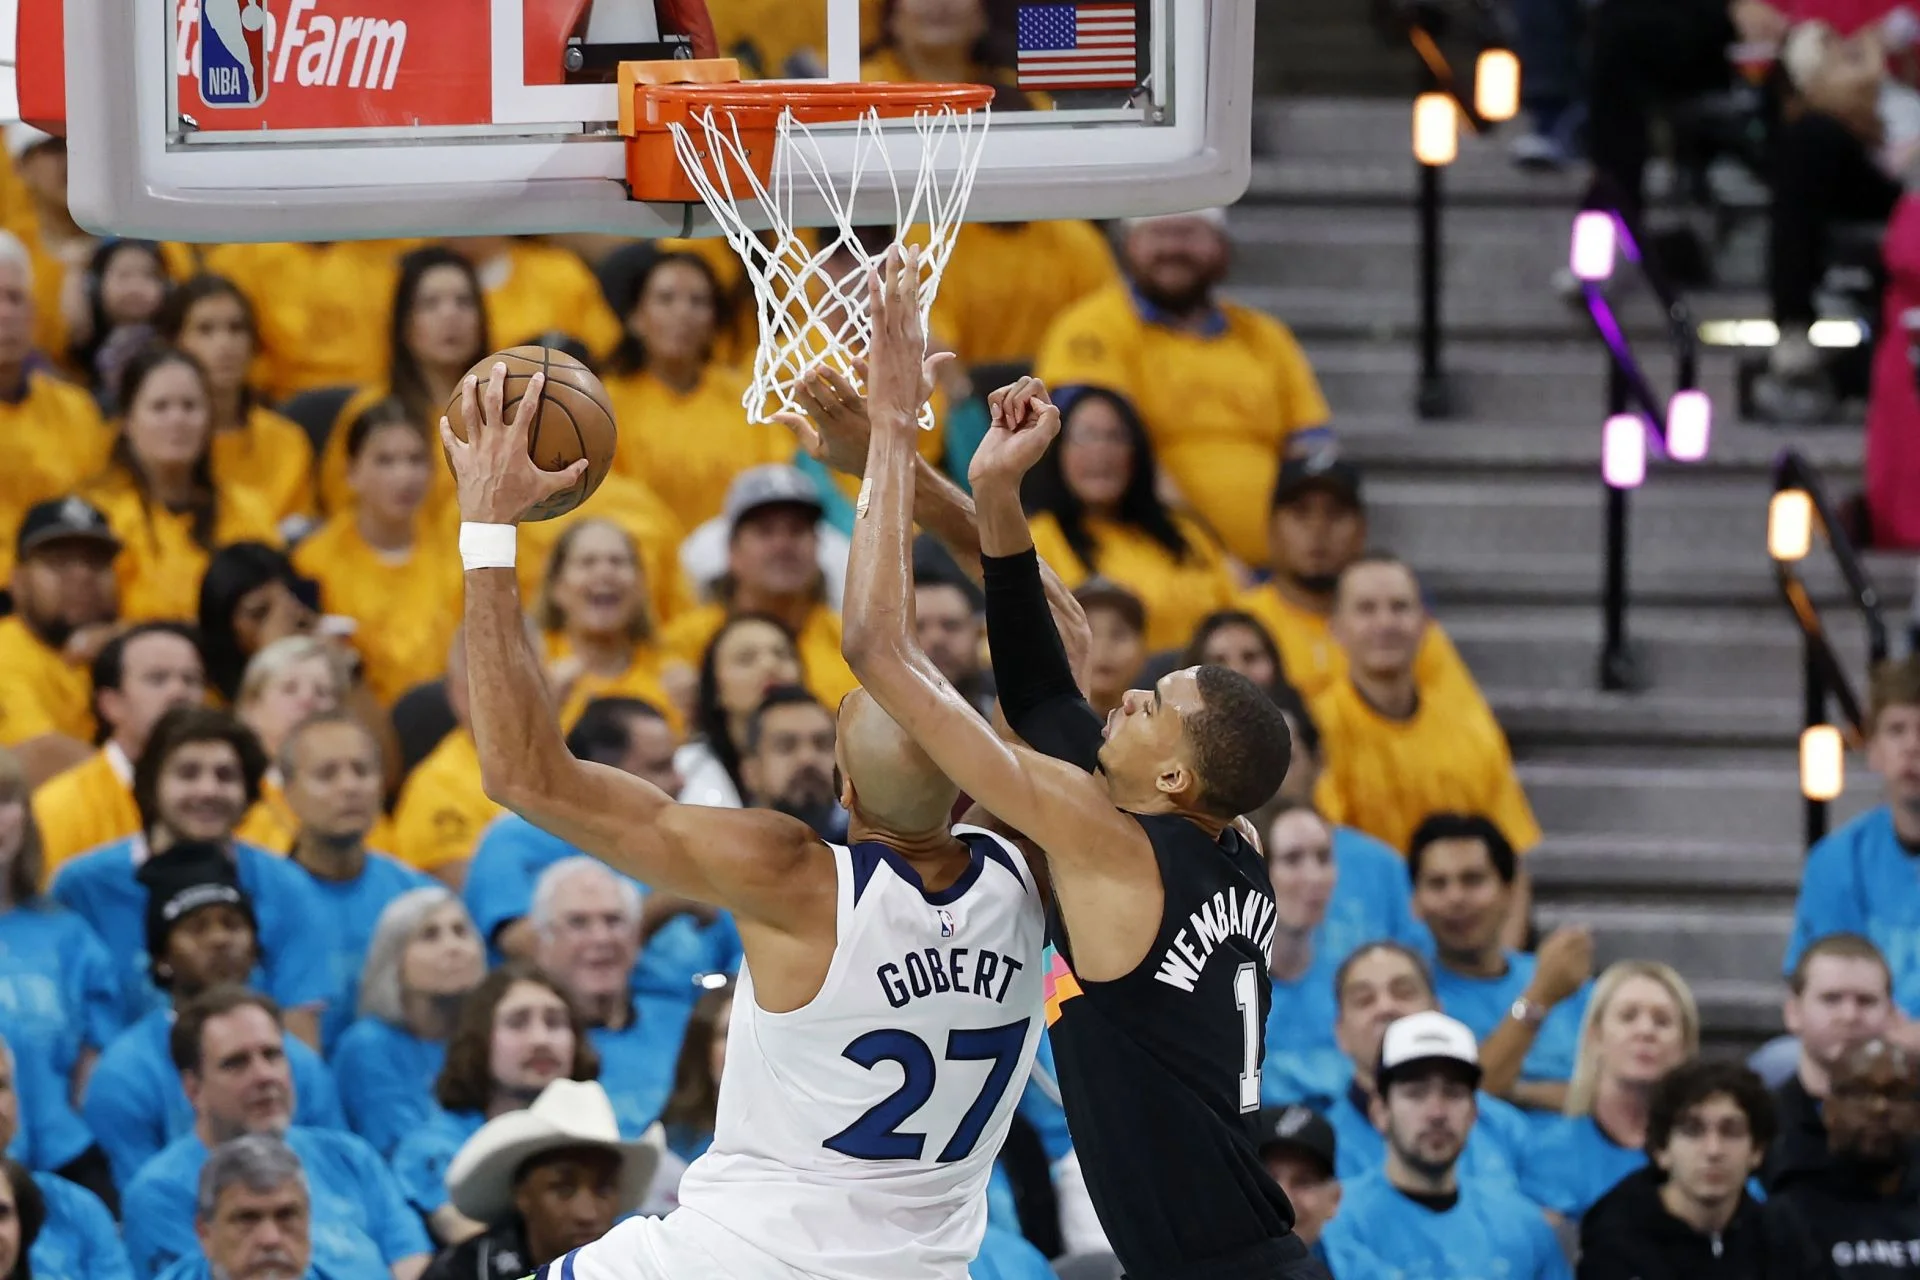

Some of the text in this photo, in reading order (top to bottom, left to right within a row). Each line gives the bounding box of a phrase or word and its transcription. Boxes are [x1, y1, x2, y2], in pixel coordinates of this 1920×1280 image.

[208, 67, 241, 96] NBA
[273, 0, 407, 90] Farm
[877, 948, 1023, 1008] GOBERT
[1154, 886, 1278, 993] WEMBANYA
[1233, 961, 1261, 1114] 1
[822, 1016, 1031, 1163] 27
